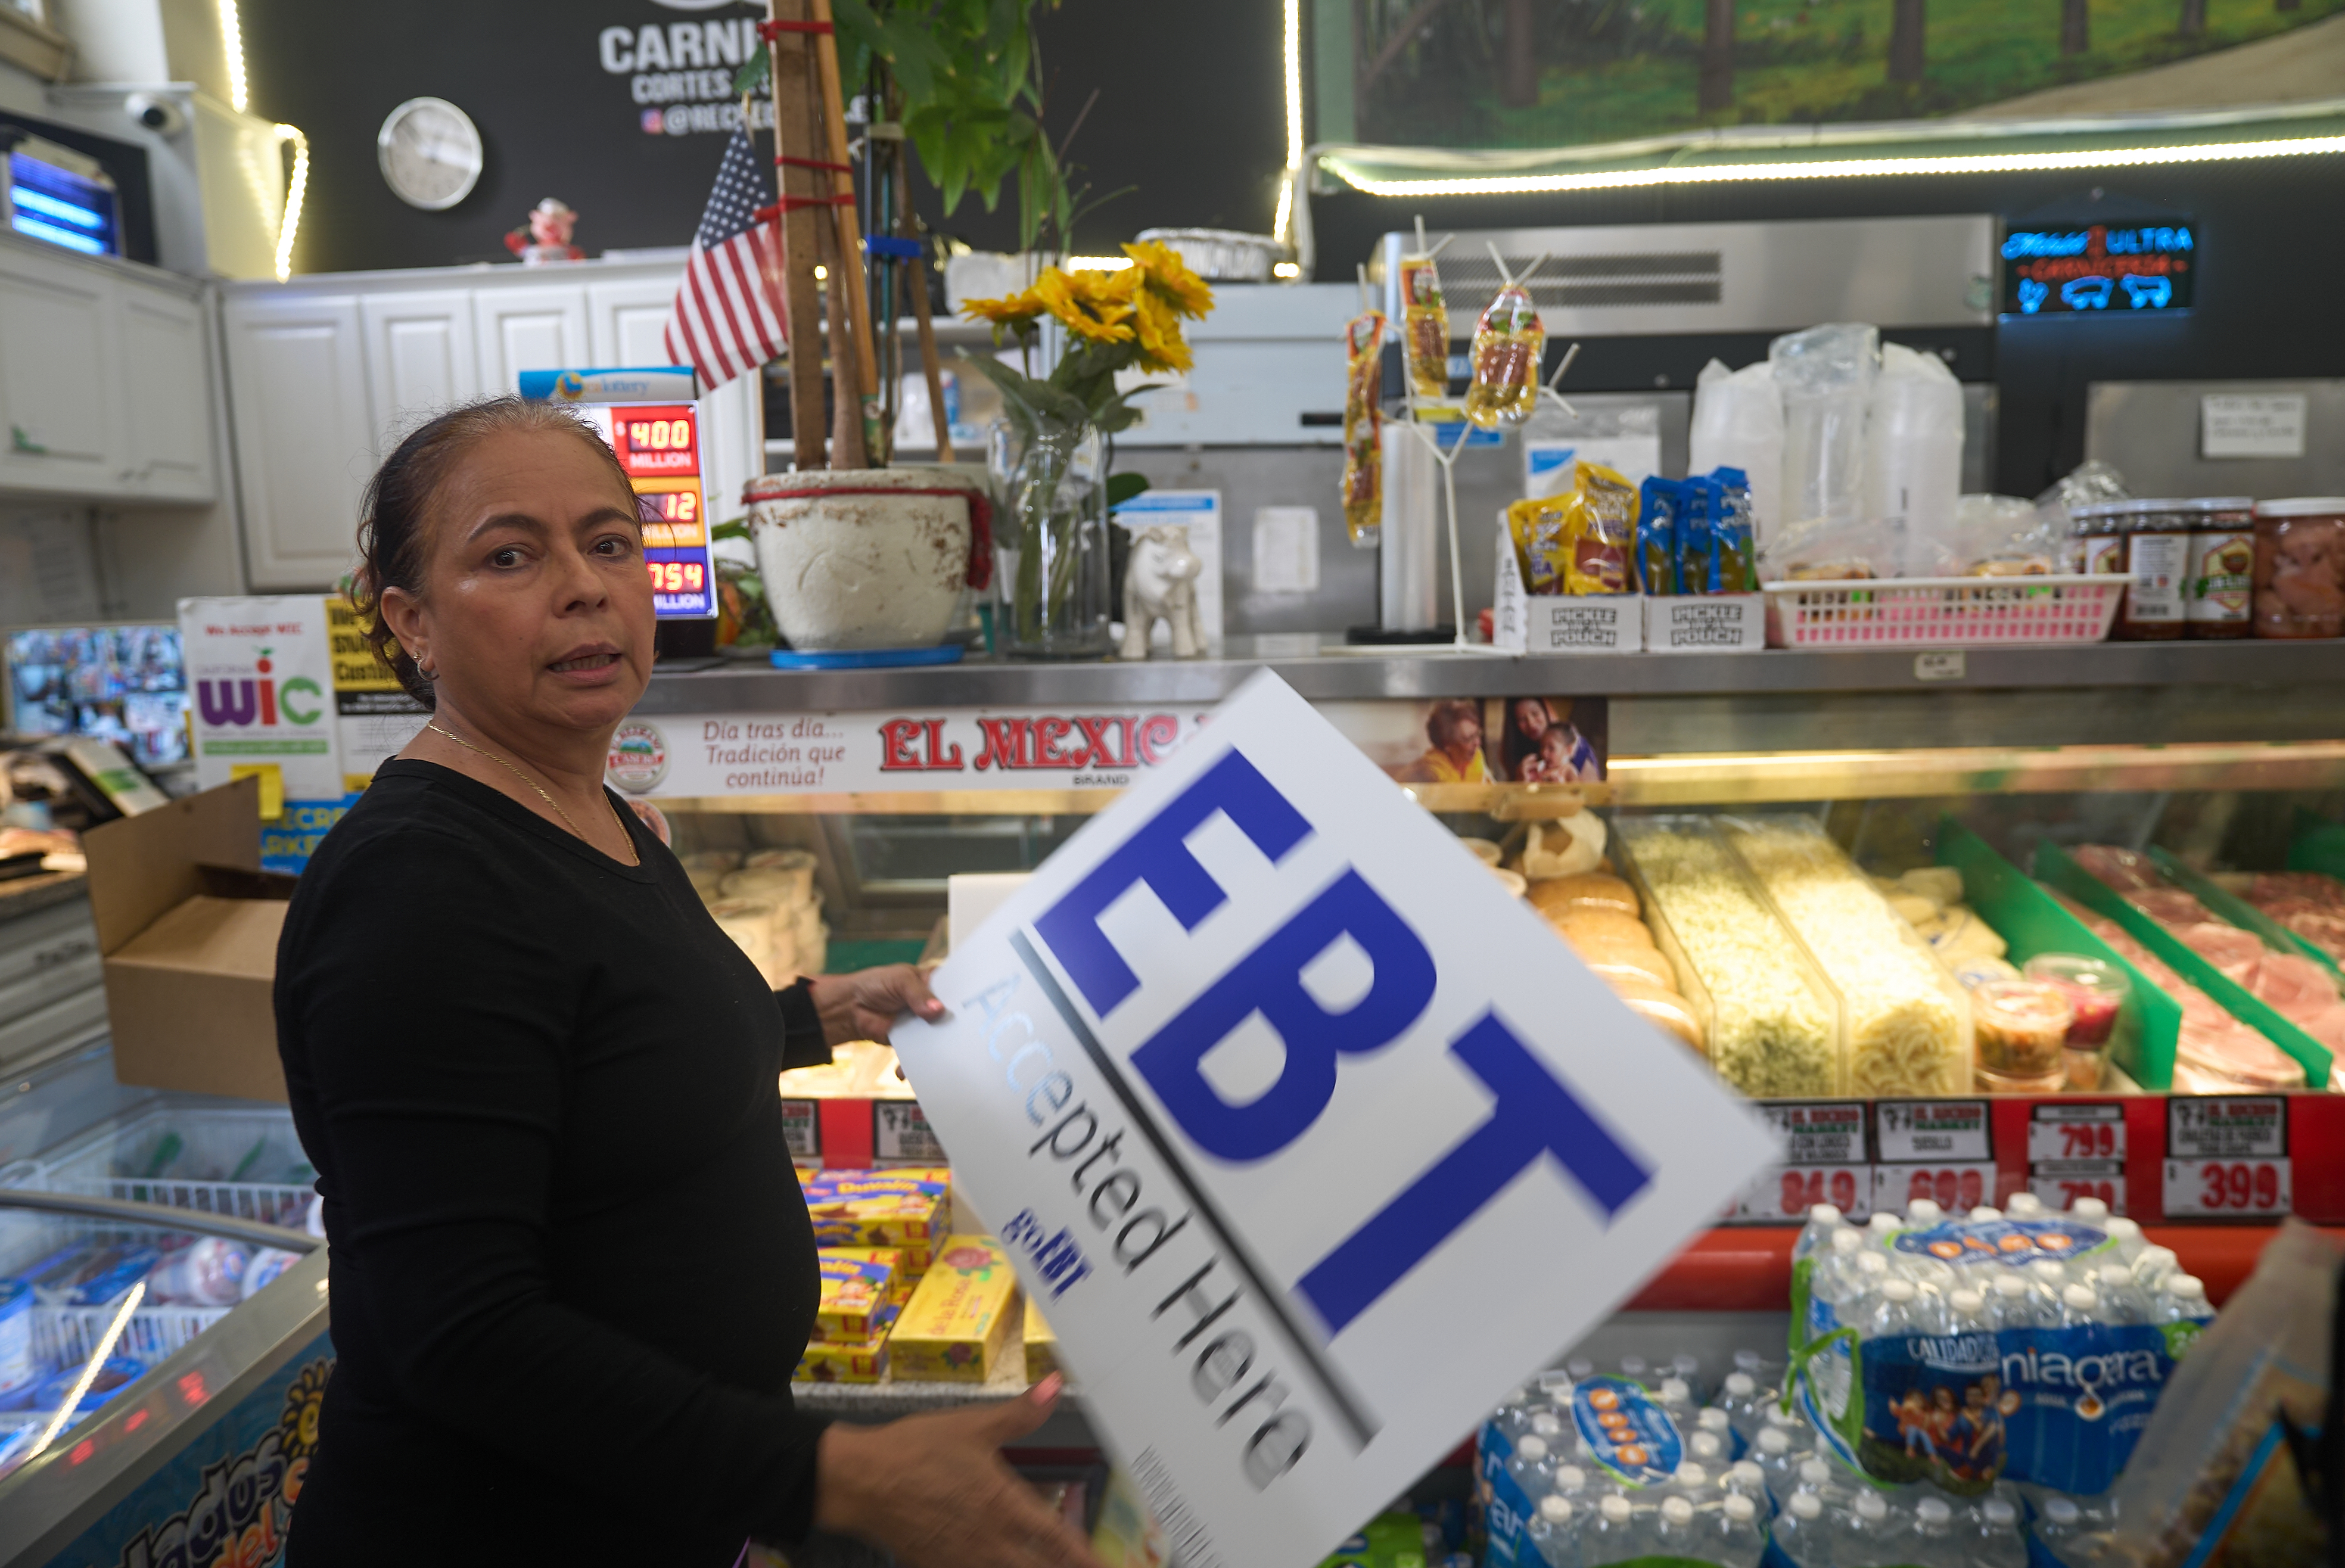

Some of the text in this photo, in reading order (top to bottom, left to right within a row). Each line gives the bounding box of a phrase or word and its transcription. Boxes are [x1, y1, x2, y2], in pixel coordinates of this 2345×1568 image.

[599, 18, 757, 74] CARNI
[630, 69, 733, 105] CORTES
[630, 419, 691, 449] 400
[629, 452, 692, 468] MILLION
[666, 491, 696, 521] 12
[653, 593, 705, 610] ILLION
[1671, 603, 1742, 624] PICKLE
[1551, 606, 1616, 626] PICKLE
[1550, 629, 1616, 648] POUCH
[1670, 627, 1742, 648] POUCH
[704, 720, 739, 741] Día
[747, 721, 785, 740] tras
[879, 714, 1183, 771] EL MEXIC
[705, 742, 846, 766] Tradición que
[726, 766, 825, 788] continúa!
[1073, 775, 1130, 786] BRAND
[1032, 745, 1660, 1348] EBT
[2060, 1122, 2113, 1158] 799
[2201, 1161, 2279, 1210] 399
[961, 972, 1195, 1280] Accepted
[1149, 1250, 1314, 1494] Here
